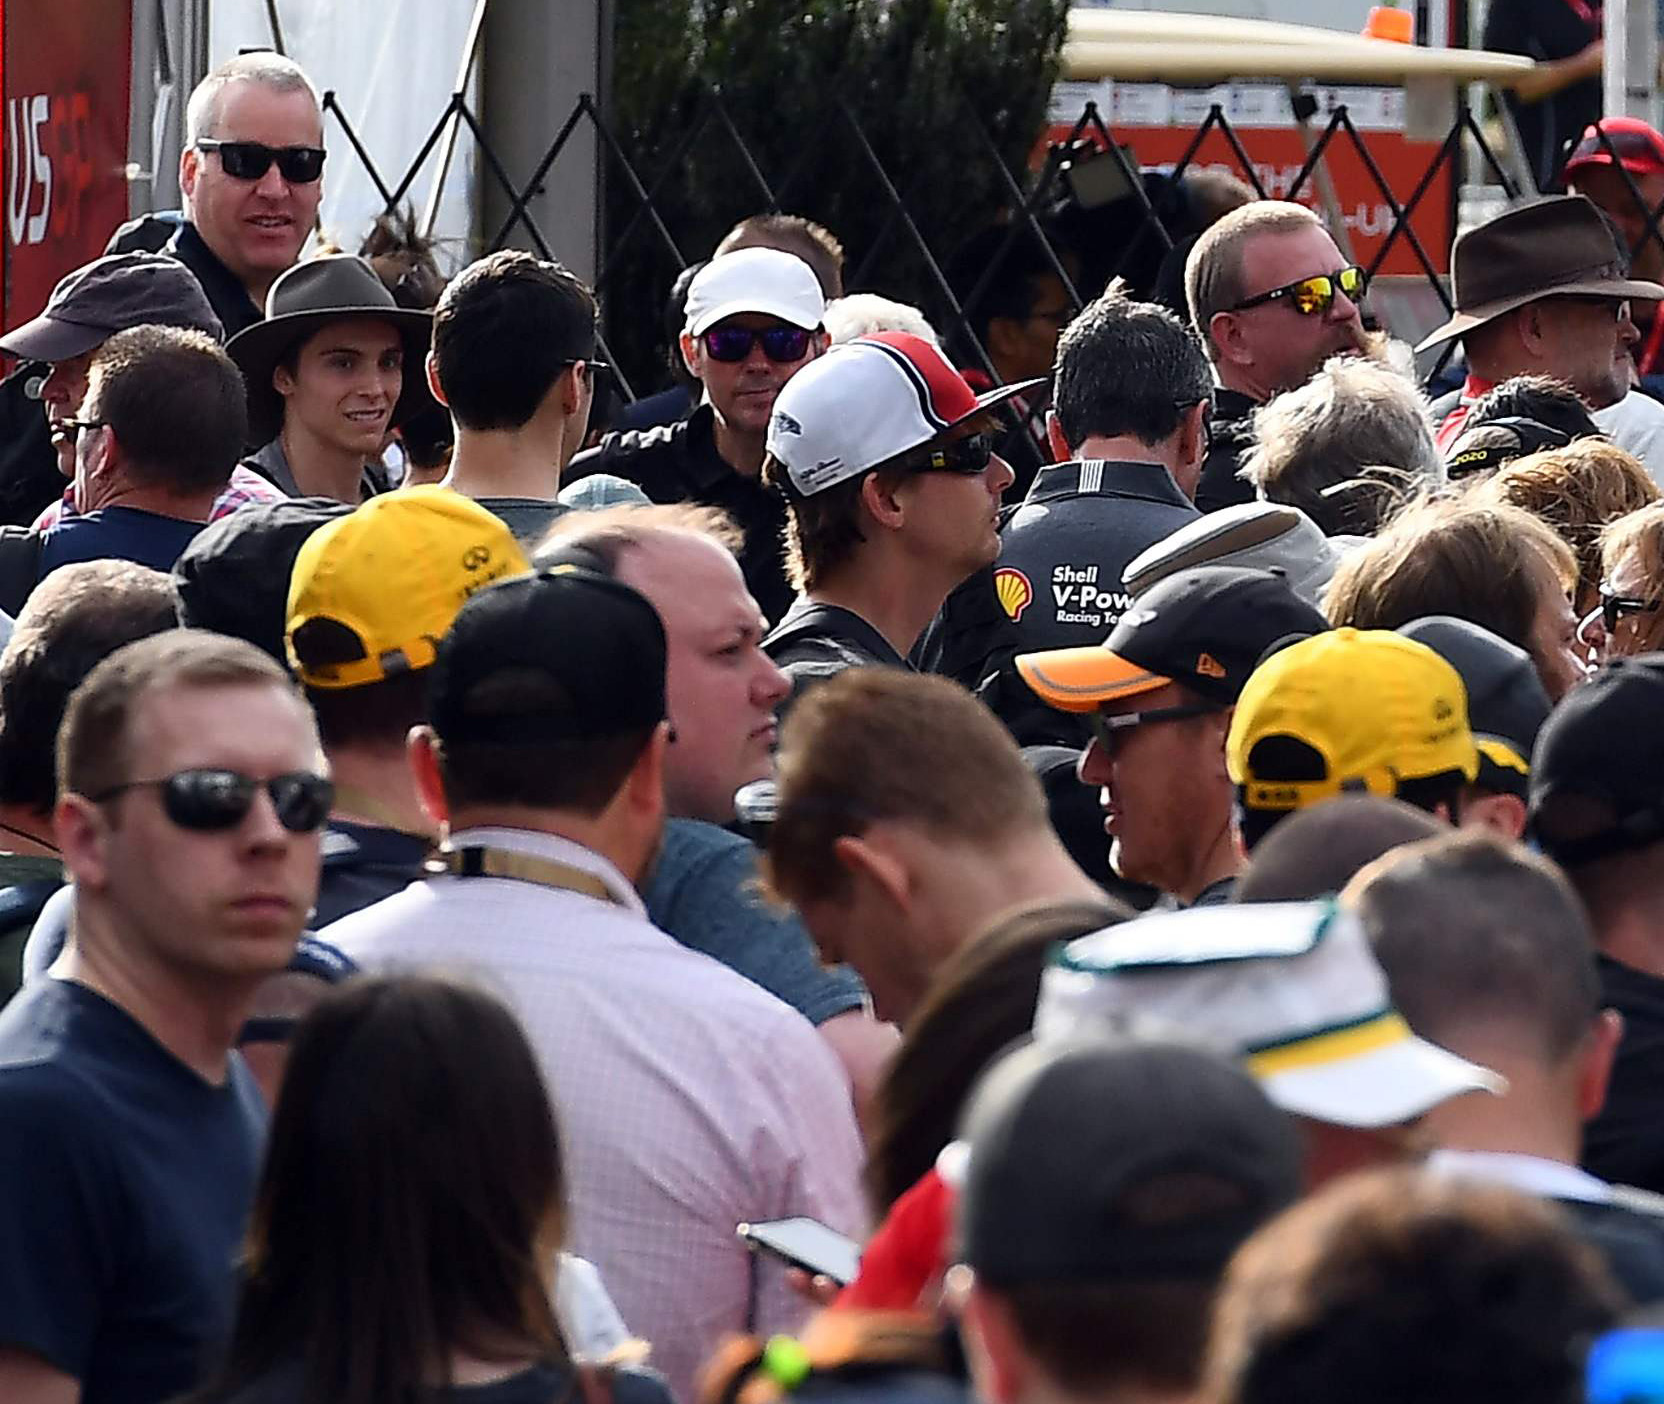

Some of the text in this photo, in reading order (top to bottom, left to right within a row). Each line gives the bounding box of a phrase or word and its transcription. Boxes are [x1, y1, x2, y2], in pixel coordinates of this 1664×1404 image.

[1052, 565, 1098, 583] Shell
[1052, 585, 1135, 610] V-Pow
[1056, 609, 1101, 627] Racing
